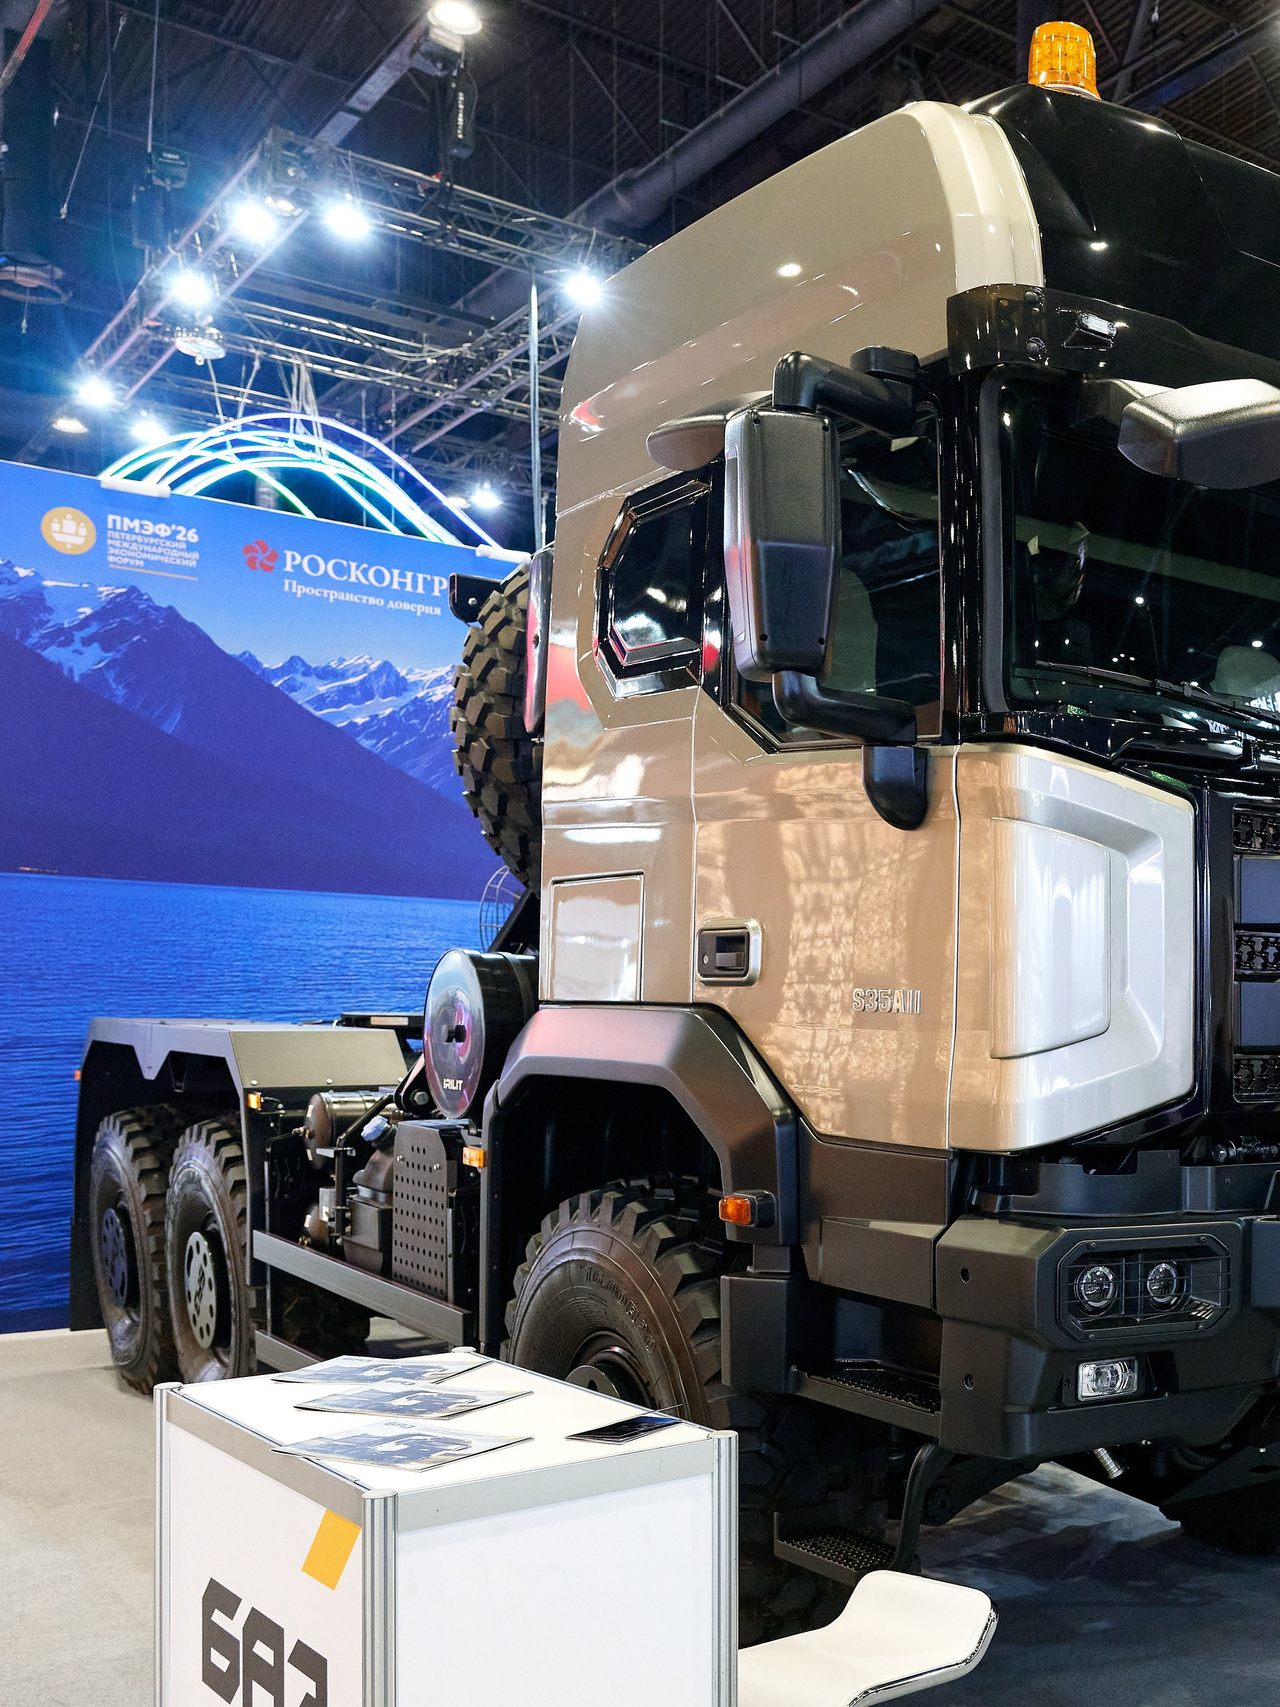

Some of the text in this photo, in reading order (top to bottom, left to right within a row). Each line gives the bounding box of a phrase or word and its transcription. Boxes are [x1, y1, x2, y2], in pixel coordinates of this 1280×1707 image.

[107, 514, 199, 543] ПМЭФ'26
[107, 530, 187, 550] ПЕТЕРБУРГСКИЙ
[107, 539, 199, 560] МЕЖДУНАРОДНЫЙ
[107, 547, 197, 568] ЭКОНОМИЧЕСКИЙ
[107, 555, 145, 567] ФОРУМ
[283, 550, 448, 597] РОСКОНГР
[283, 579, 442, 616] Пространство доверия
